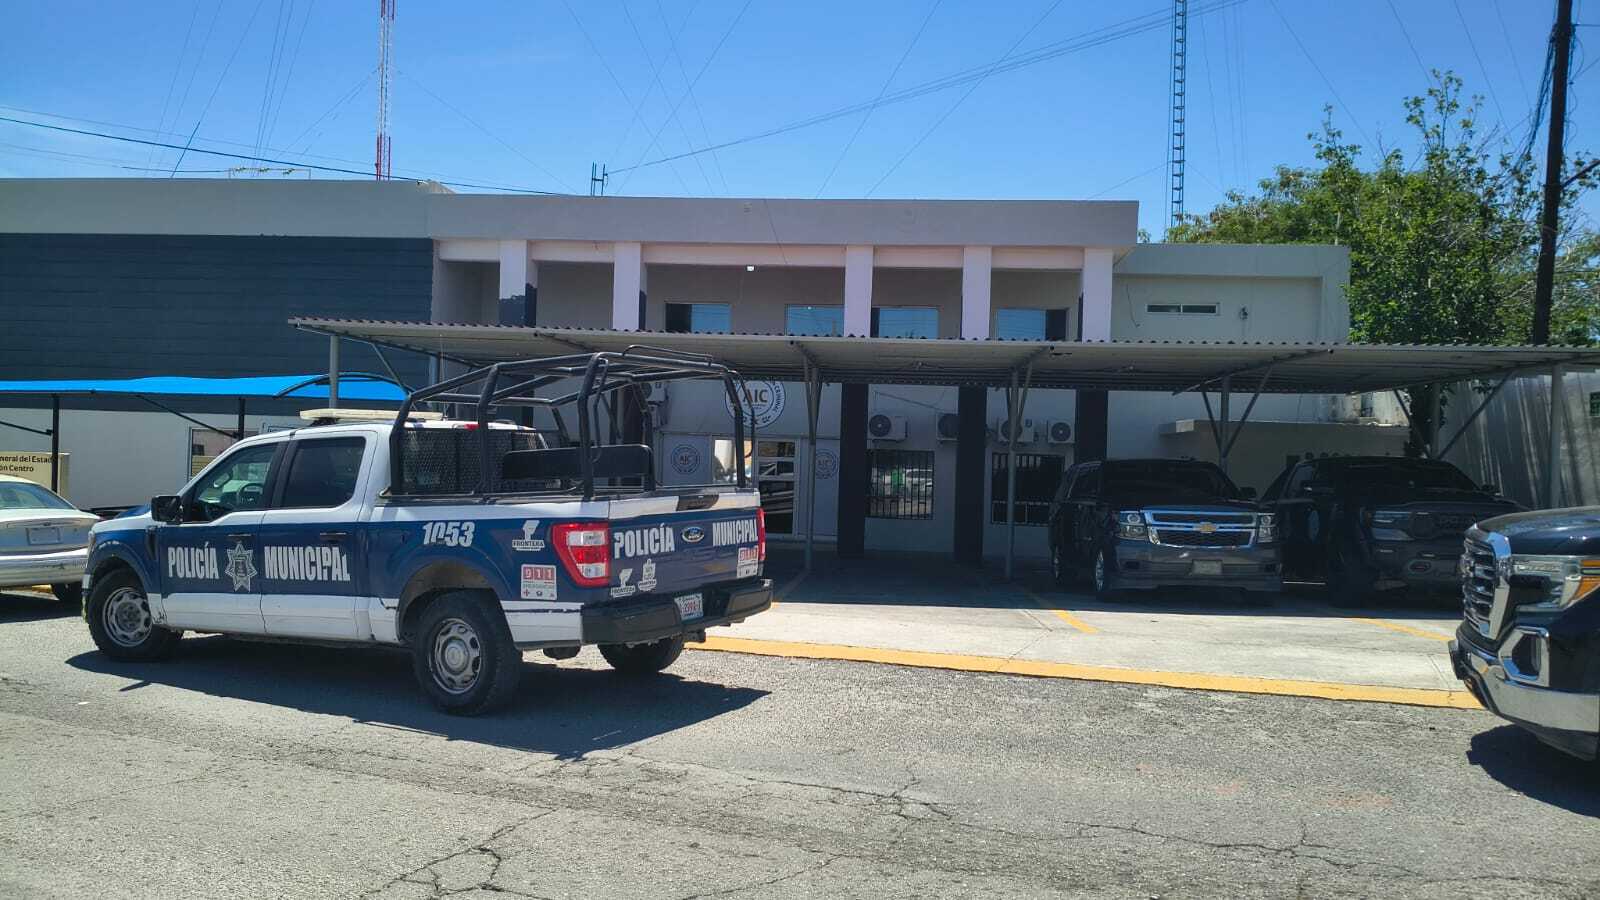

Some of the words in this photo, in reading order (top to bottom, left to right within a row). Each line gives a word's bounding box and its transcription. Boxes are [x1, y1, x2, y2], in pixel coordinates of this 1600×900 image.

[422, 520, 476, 548] 1053
[613, 523, 675, 559] POLICÍA
[712, 519, 758, 547] MUNICIPAL
[167, 541, 219, 580] POLICÍA
[264, 546, 351, 582] MUNICIPAL
[525, 568, 552, 579] 911
